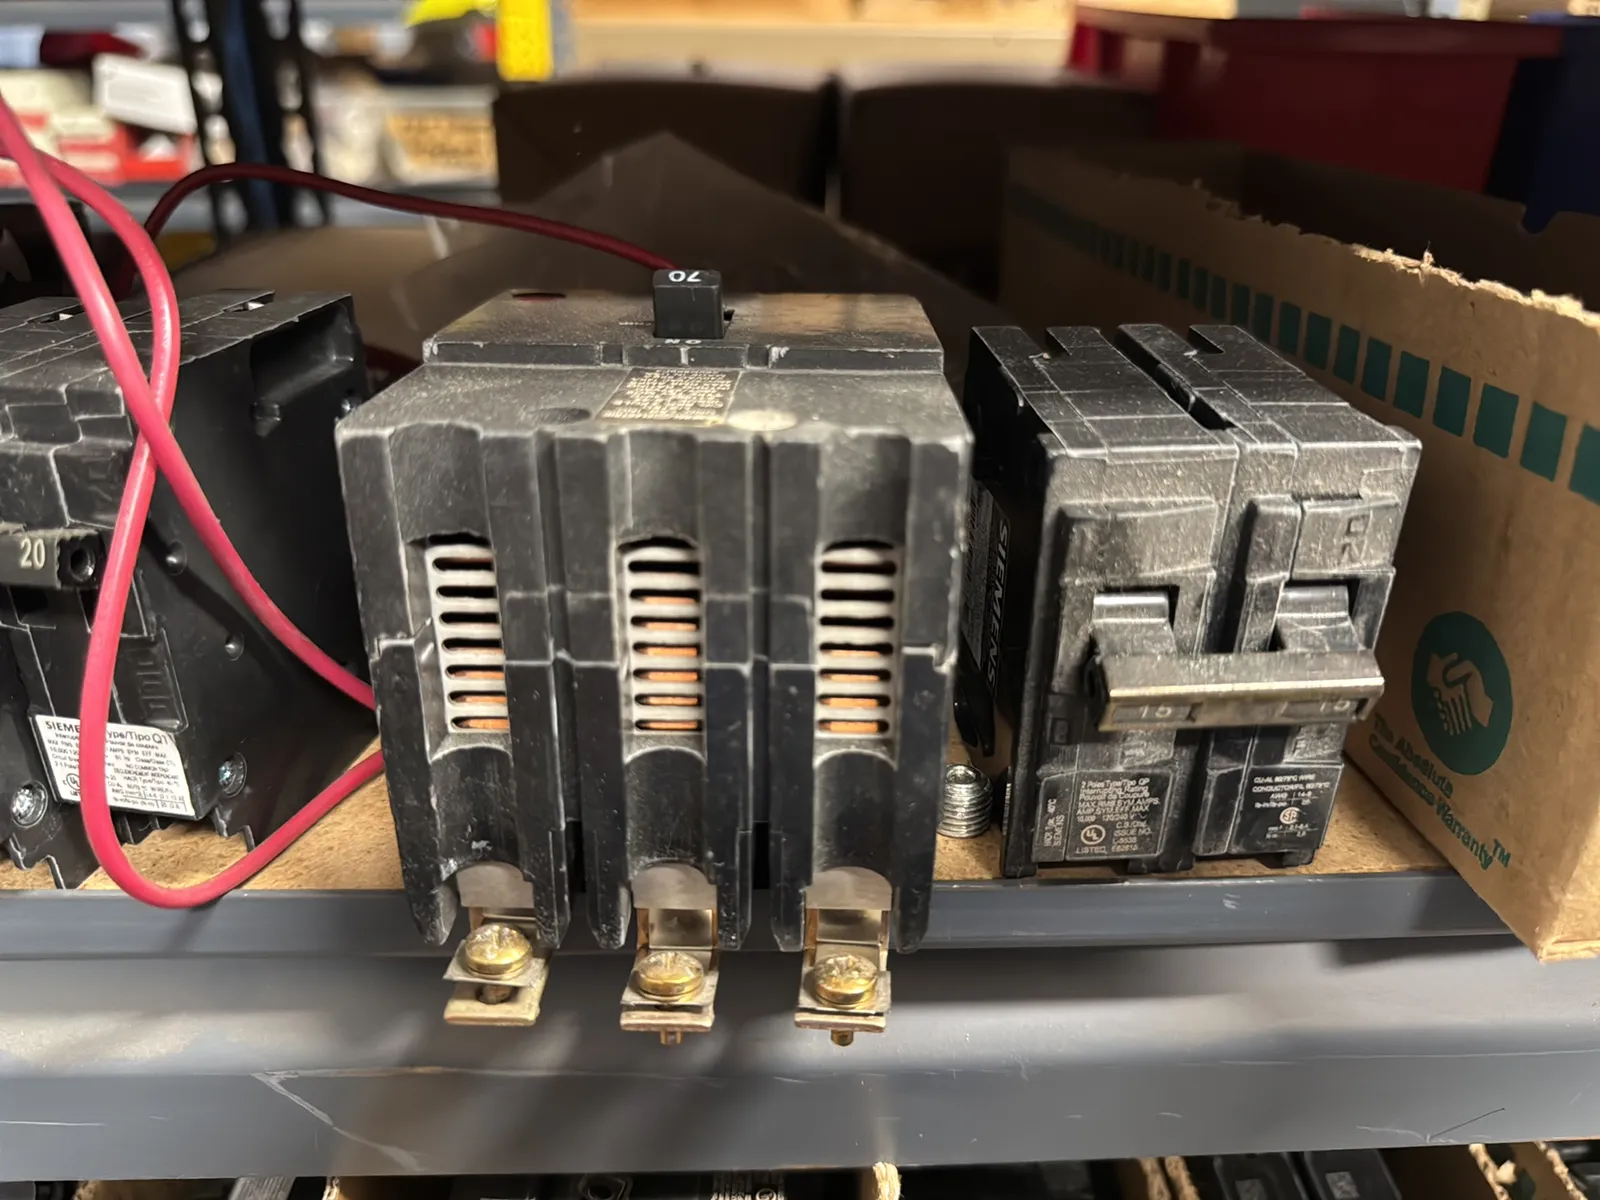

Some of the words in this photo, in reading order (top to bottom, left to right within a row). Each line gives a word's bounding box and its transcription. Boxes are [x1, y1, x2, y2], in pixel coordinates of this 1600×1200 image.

[668, 270, 702, 282] 70
[20, 538, 46, 569] 20
[987, 520, 1009, 688] SIEMENS
[1140, 705, 1173, 718] 15
[1319, 700, 1351, 712] 15
[45, 720, 81, 734] SIEME
[105, 730, 151, 742] ype/Tipo
[1394, 737, 1454, 799] Absolute
[1436, 796, 1495, 871] Warranty
